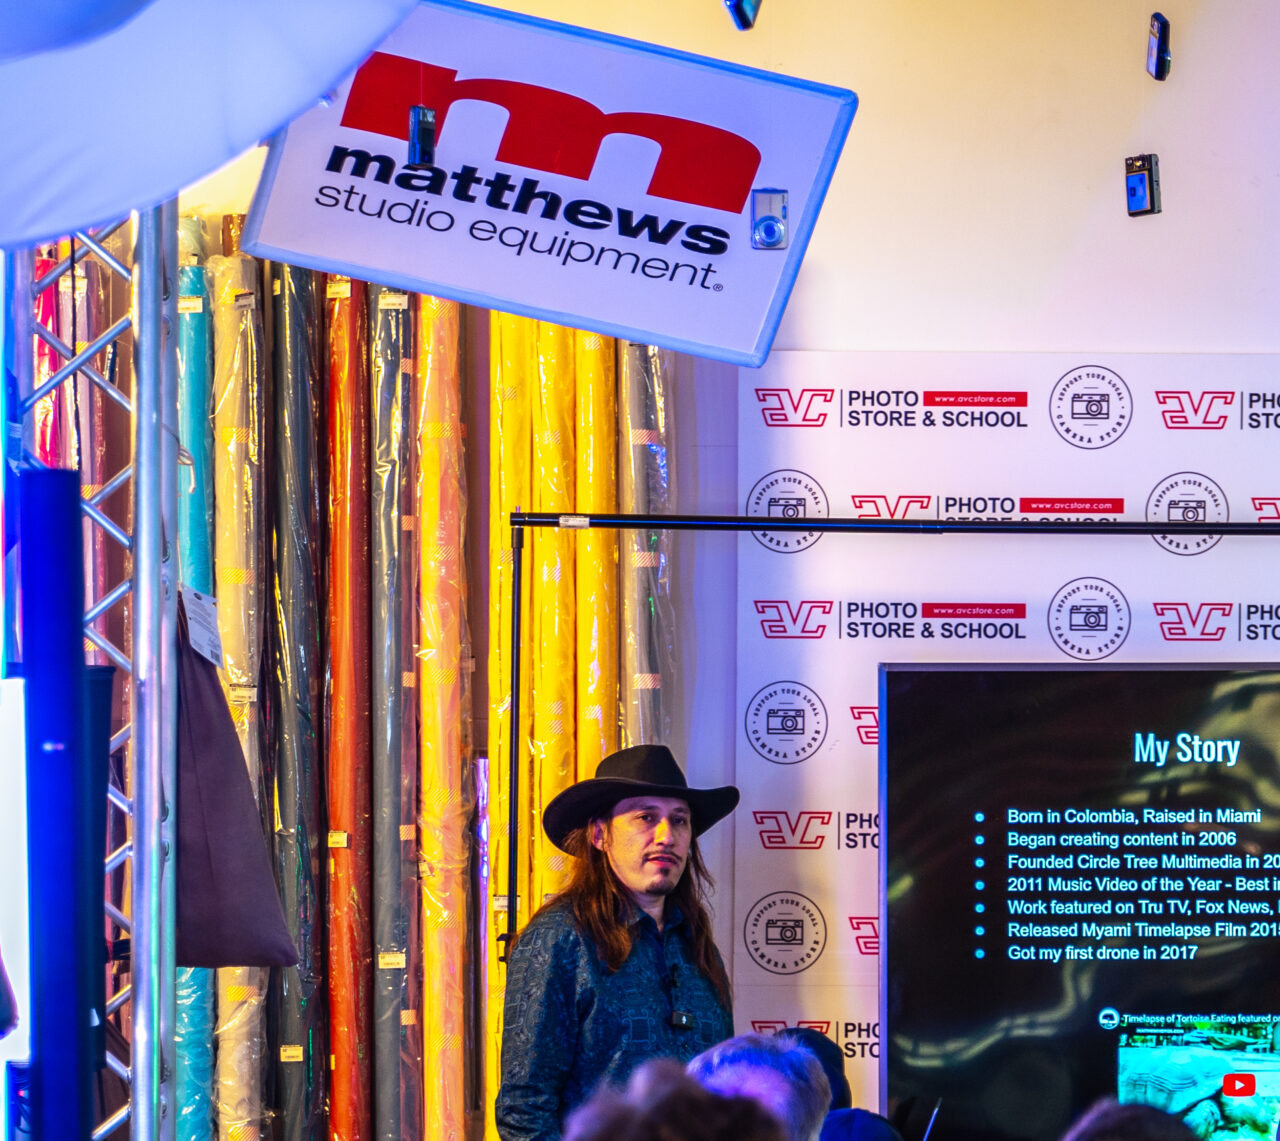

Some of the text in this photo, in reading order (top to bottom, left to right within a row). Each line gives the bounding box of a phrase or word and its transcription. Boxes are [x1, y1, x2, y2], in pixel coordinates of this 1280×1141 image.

[314, 183, 456, 233] studio
[324, 144, 730, 256] matthews
[1057, 372, 1126, 402] SUPPORT YOUR LOCAL
[848, 390, 919, 407] PHOTO
[934, 395, 1016, 403] www.avcstore.com
[847, 410, 1028, 428] STORE & SCHOOL
[1055, 413, 1127, 444] CAMERA STORE
[945, 496, 1016, 514] PHOTO
[1030, 502, 1113, 510] www.avcstore.com
[1055, 584, 1124, 614] SUPPORT YOUR LOCAL
[847, 602, 918, 619] PHOTO
[933, 607, 1015, 615] www.avcstore.com
[846, 621, 1027, 639] STORE & SCHOOL
[1053, 625, 1125, 656] CAMERA STORE
[1134, 732, 1241, 768] My Story
[1007, 808, 1262, 826] Born in Colombia, Raised in Miami
[1007, 831, 1237, 850] Began creating content in 2006
[1008, 854, 1074, 869] Founded
[1076, 854, 1121, 869] Circle
[1123, 853, 1159, 869] Tree
[1161, 853, 1243, 869] Multimedia
[1245, 853, 1260, 869] in
[1007, 876, 1042, 892] 2011
[1048, 876, 1093, 892] Music
[1094, 876, 1139, 892] Video
[1140, 876, 1158, 892] of
[1159, 876, 1185, 892] the
[1186, 876, 1223, 892] Year
[1235, 876, 1270, 892] Best
[751, 898, 820, 928] SUPPORT YOUR LOCAL
[1007, 899, 1048, 915] Work
[1049, 899, 1112, 915] featured
[1114, 902, 1135, 915] on
[1137, 899, 1164, 915] Tru
[1166, 899, 1192, 916] TV,
[1195, 899, 1225, 914] Fox
[1227, 899, 1274, 916] News,
[1008, 922, 1078, 937] Released
[1081, 922, 1132, 941] Myami
[1134, 922, 1212, 940] Timelapse
[1214, 922, 1247, 937] Film
[750, 939, 821, 970] CAMERA STORE
[1007, 944, 1199, 964] Got my first drone in 2017
[1123, 1013, 1165, 1025] Timelapse
[1166, 1013, 1176, 1023] of
[1211, 1013, 1237, 1025] Eating
[1238, 1013, 1272, 1023] featured
